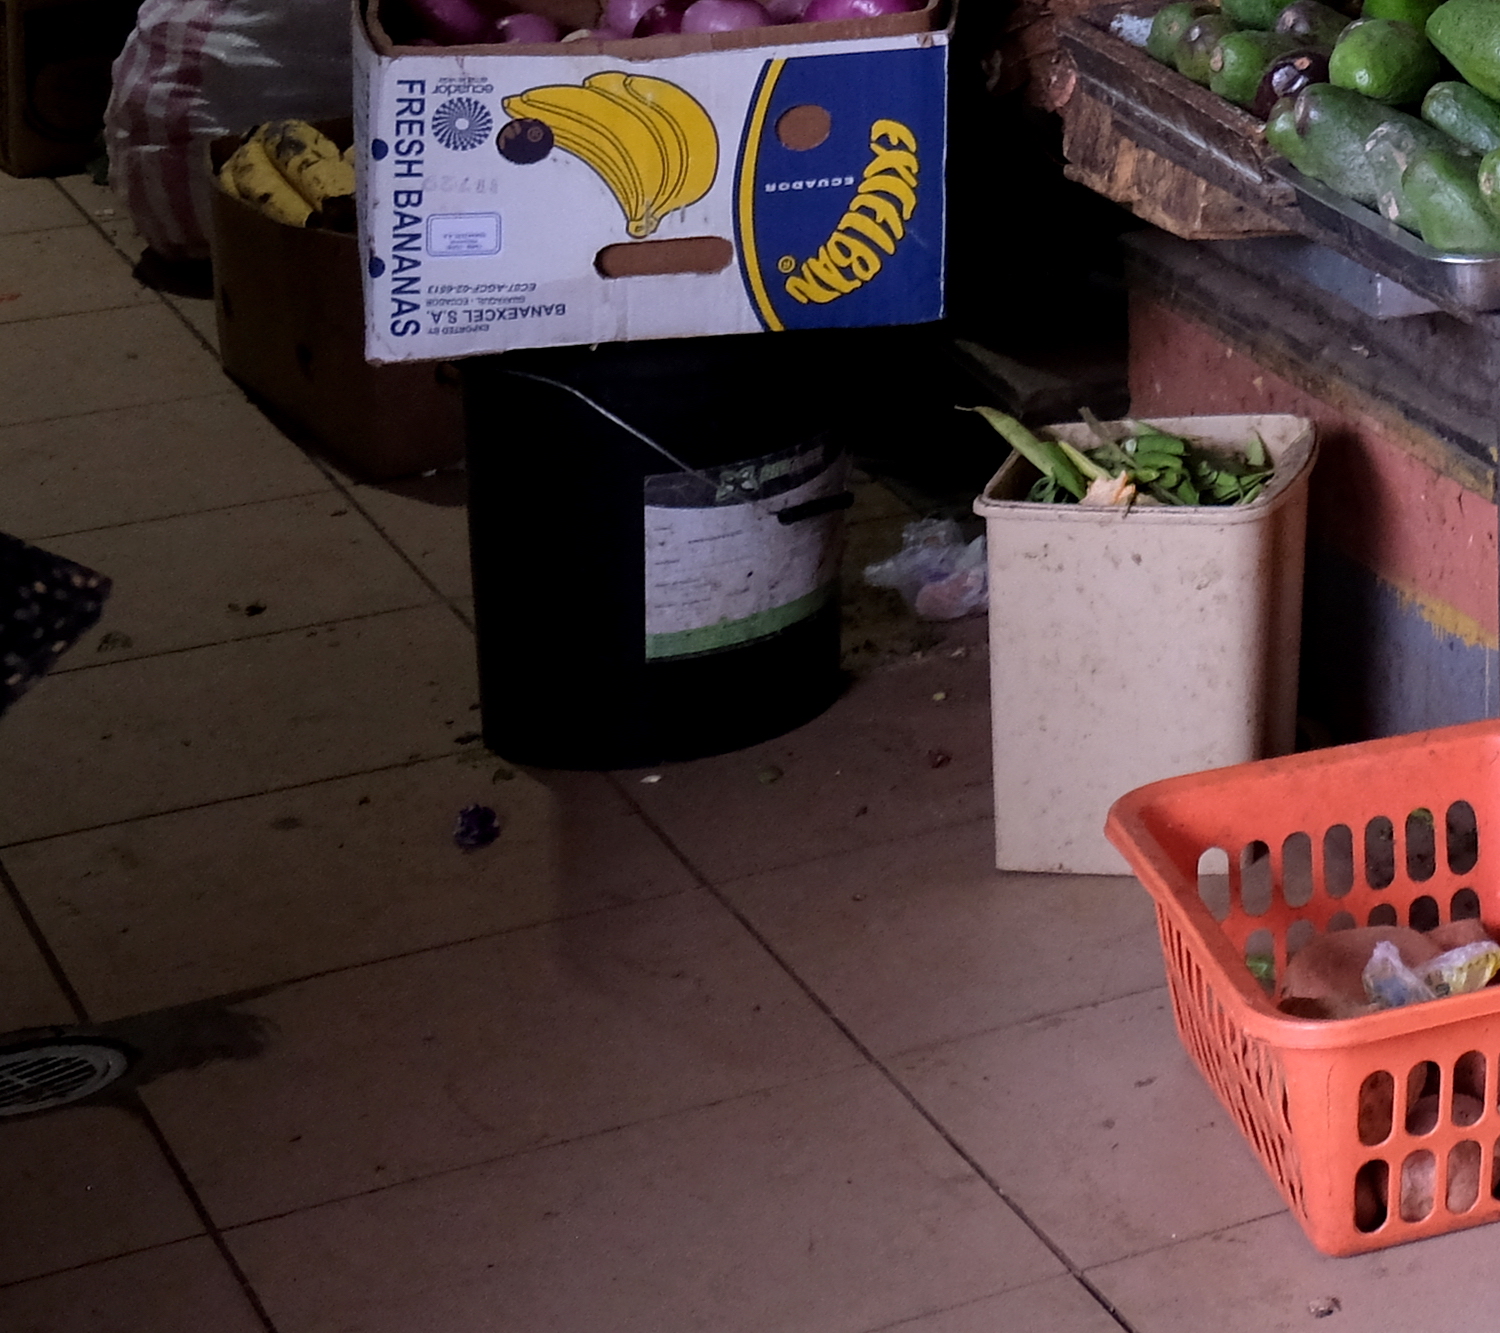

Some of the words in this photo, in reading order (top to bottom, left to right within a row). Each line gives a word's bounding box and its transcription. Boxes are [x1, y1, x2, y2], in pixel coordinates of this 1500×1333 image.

[431, 83, 494, 95] ecuador
[394, 79, 426, 177] FRESH
[765, 176, 855, 192] ECUADOR
[390, 190, 423, 337] BANANAS
[426, 310, 457, 324] S.A.
[463, 303, 566, 323] BANAEXCEL
